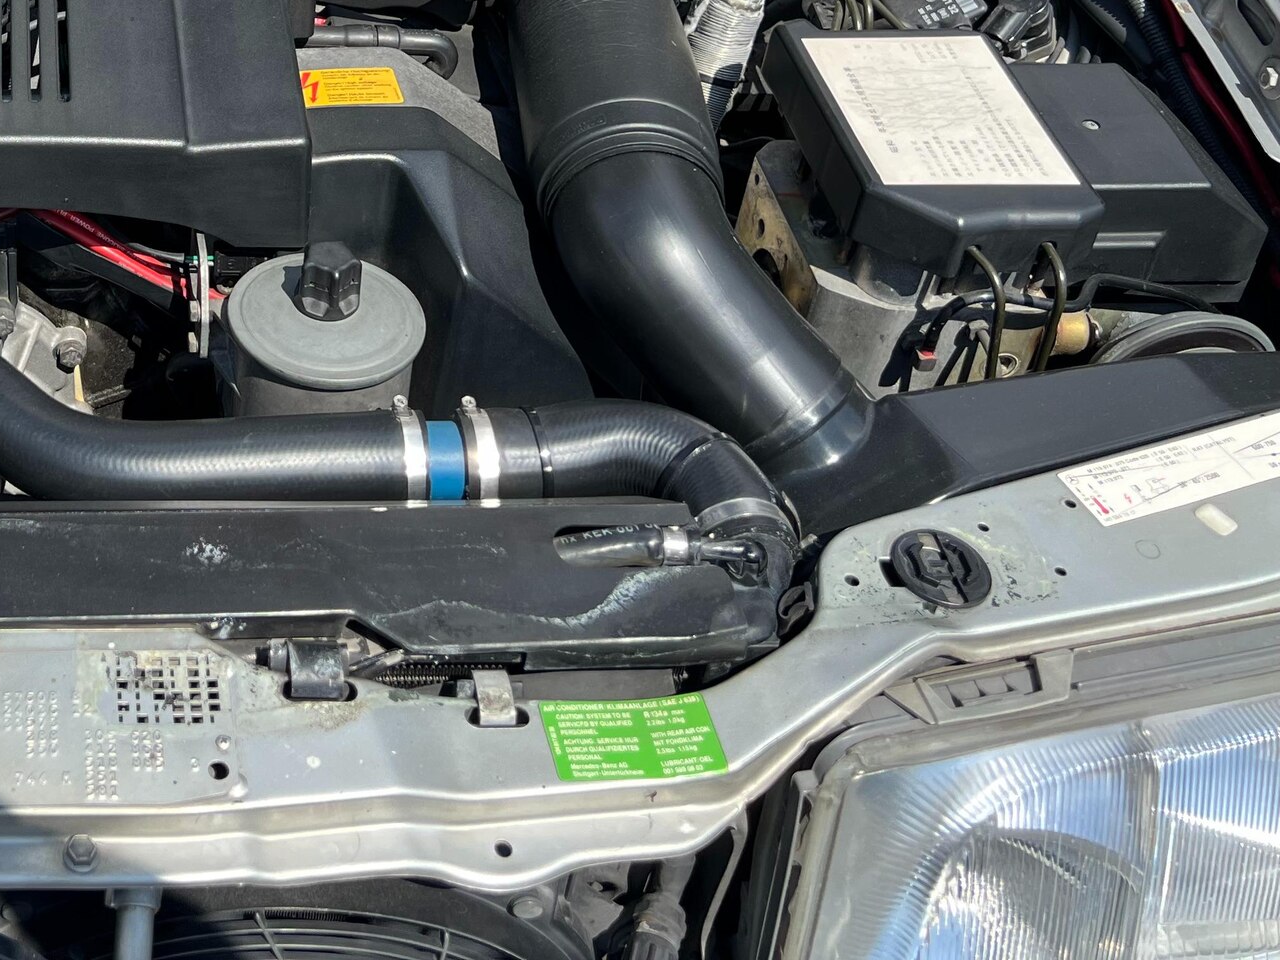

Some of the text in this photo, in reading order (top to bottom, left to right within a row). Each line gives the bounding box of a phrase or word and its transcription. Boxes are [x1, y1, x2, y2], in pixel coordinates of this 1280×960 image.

[948, 4, 959, 14] 32
[543, 704, 555, 712] AIR
[556, 703, 604, 711] CONDITIONER
